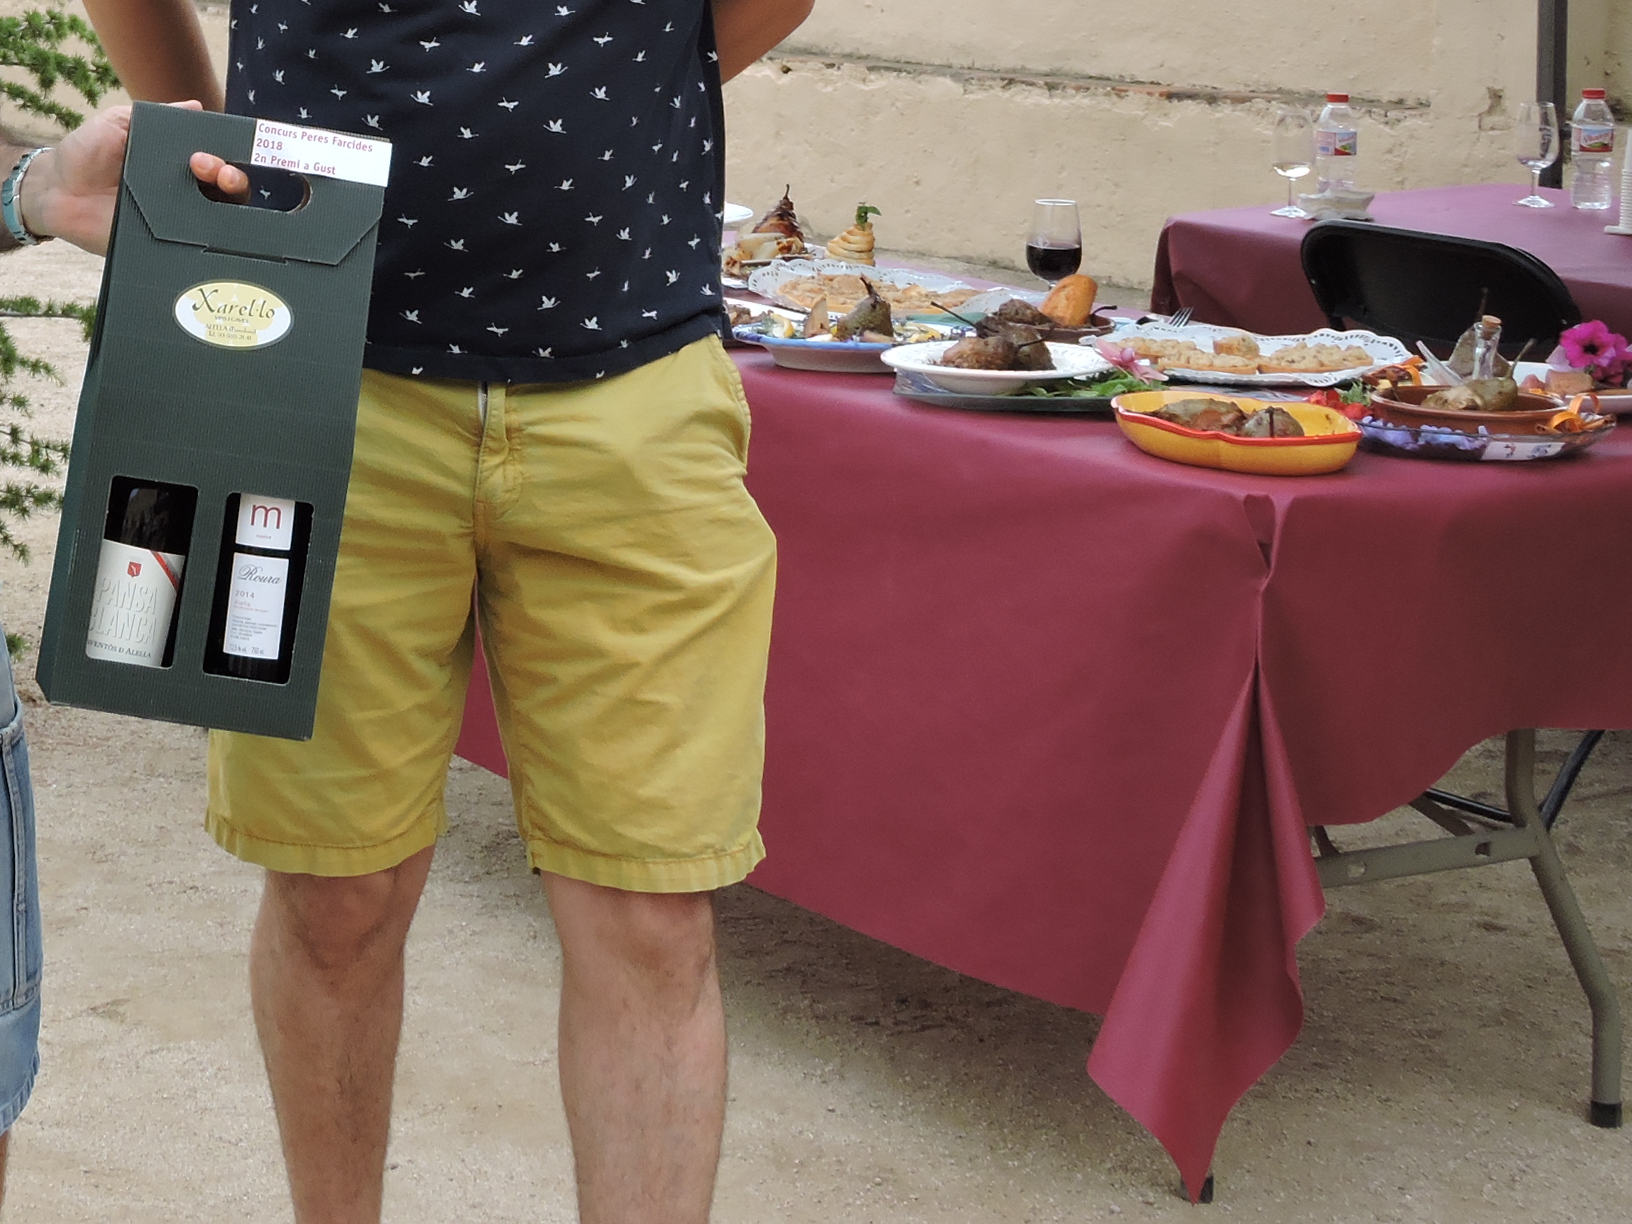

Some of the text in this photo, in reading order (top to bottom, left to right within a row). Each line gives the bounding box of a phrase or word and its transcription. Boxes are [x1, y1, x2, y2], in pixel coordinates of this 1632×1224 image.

[256, 138, 283, 151] 2018
[258, 123, 373, 152] Concurs Peres Farcides
[254, 152, 267, 164] 2n
[270, 155, 300, 169] Premi
[313, 162, 336, 175] Gust
[251, 504, 282, 529] m
[237, 564, 282, 585] Roura
[95, 578, 158, 614] PANSA
[235, 589, 255, 599] 2014
